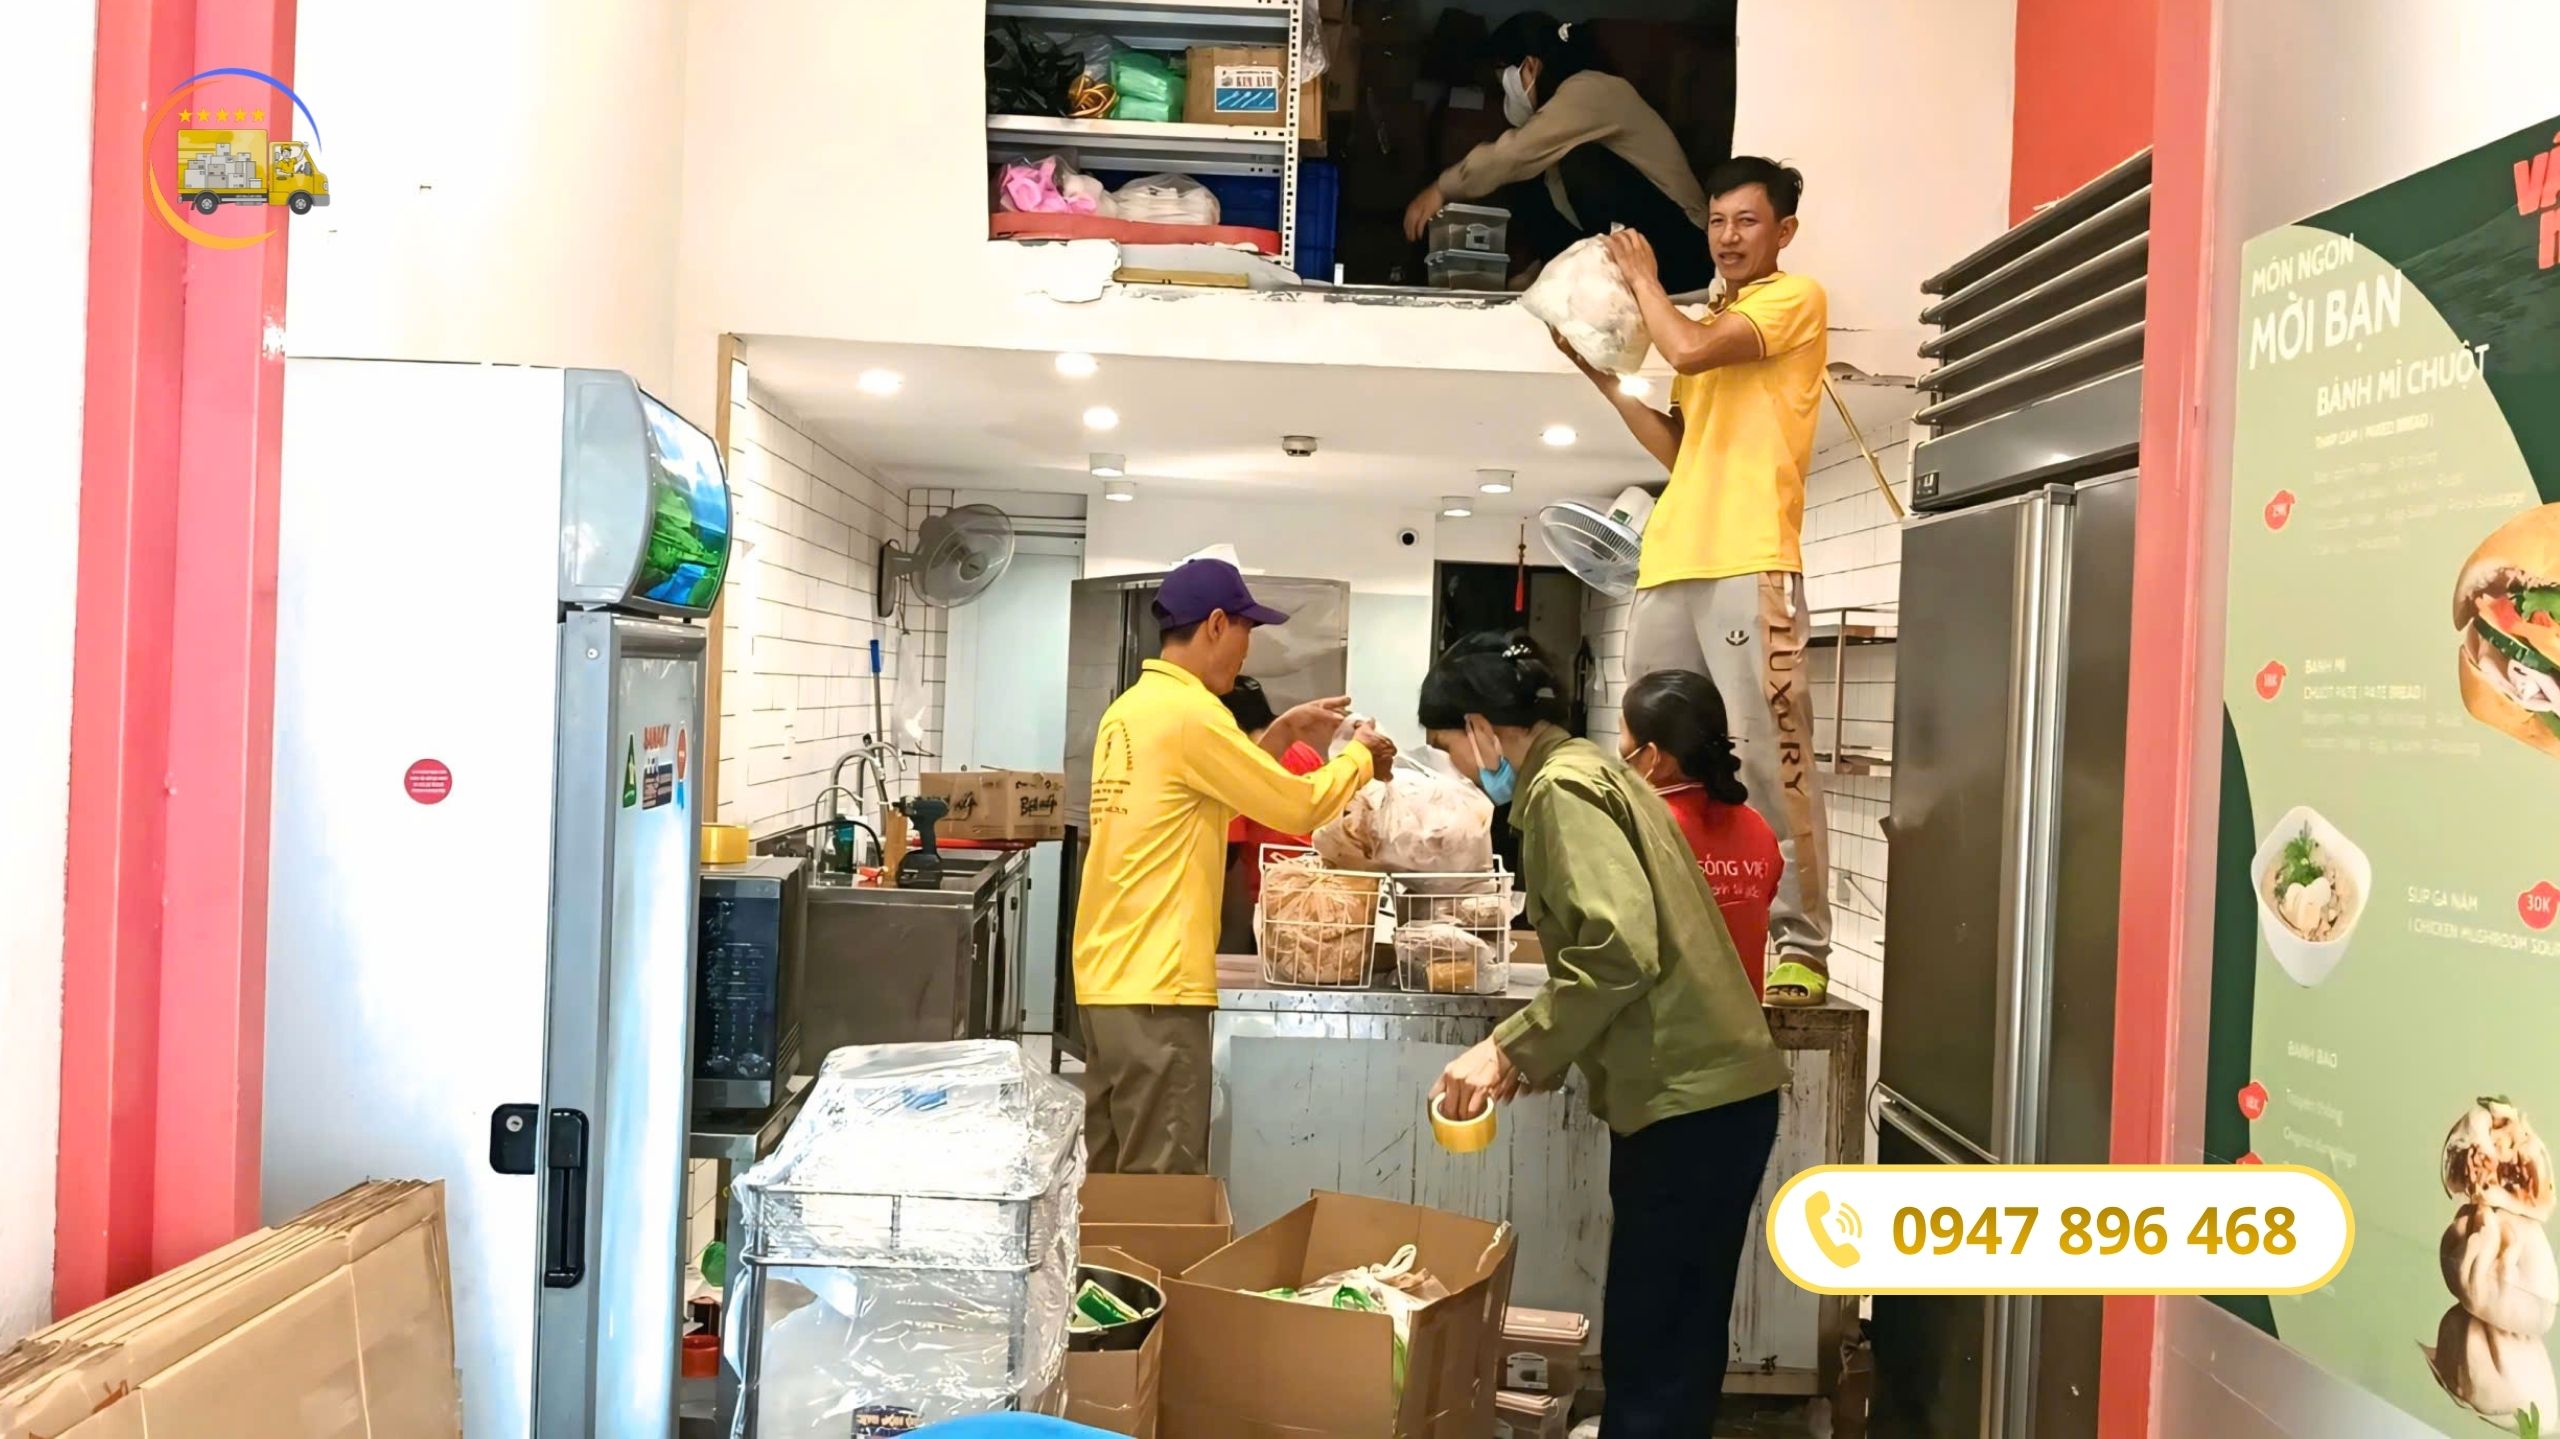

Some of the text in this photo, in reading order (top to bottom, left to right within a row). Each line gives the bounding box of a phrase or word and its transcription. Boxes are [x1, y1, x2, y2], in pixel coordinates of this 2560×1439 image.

[2298, 232, 2354, 280] NGON
[2248, 268, 2402, 370] MỜI BẠN
[2406, 339, 2490, 395] CHUỘT
[1769, 625, 1806, 797] LUXURY
[2526, 893, 2550, 913] 30K
